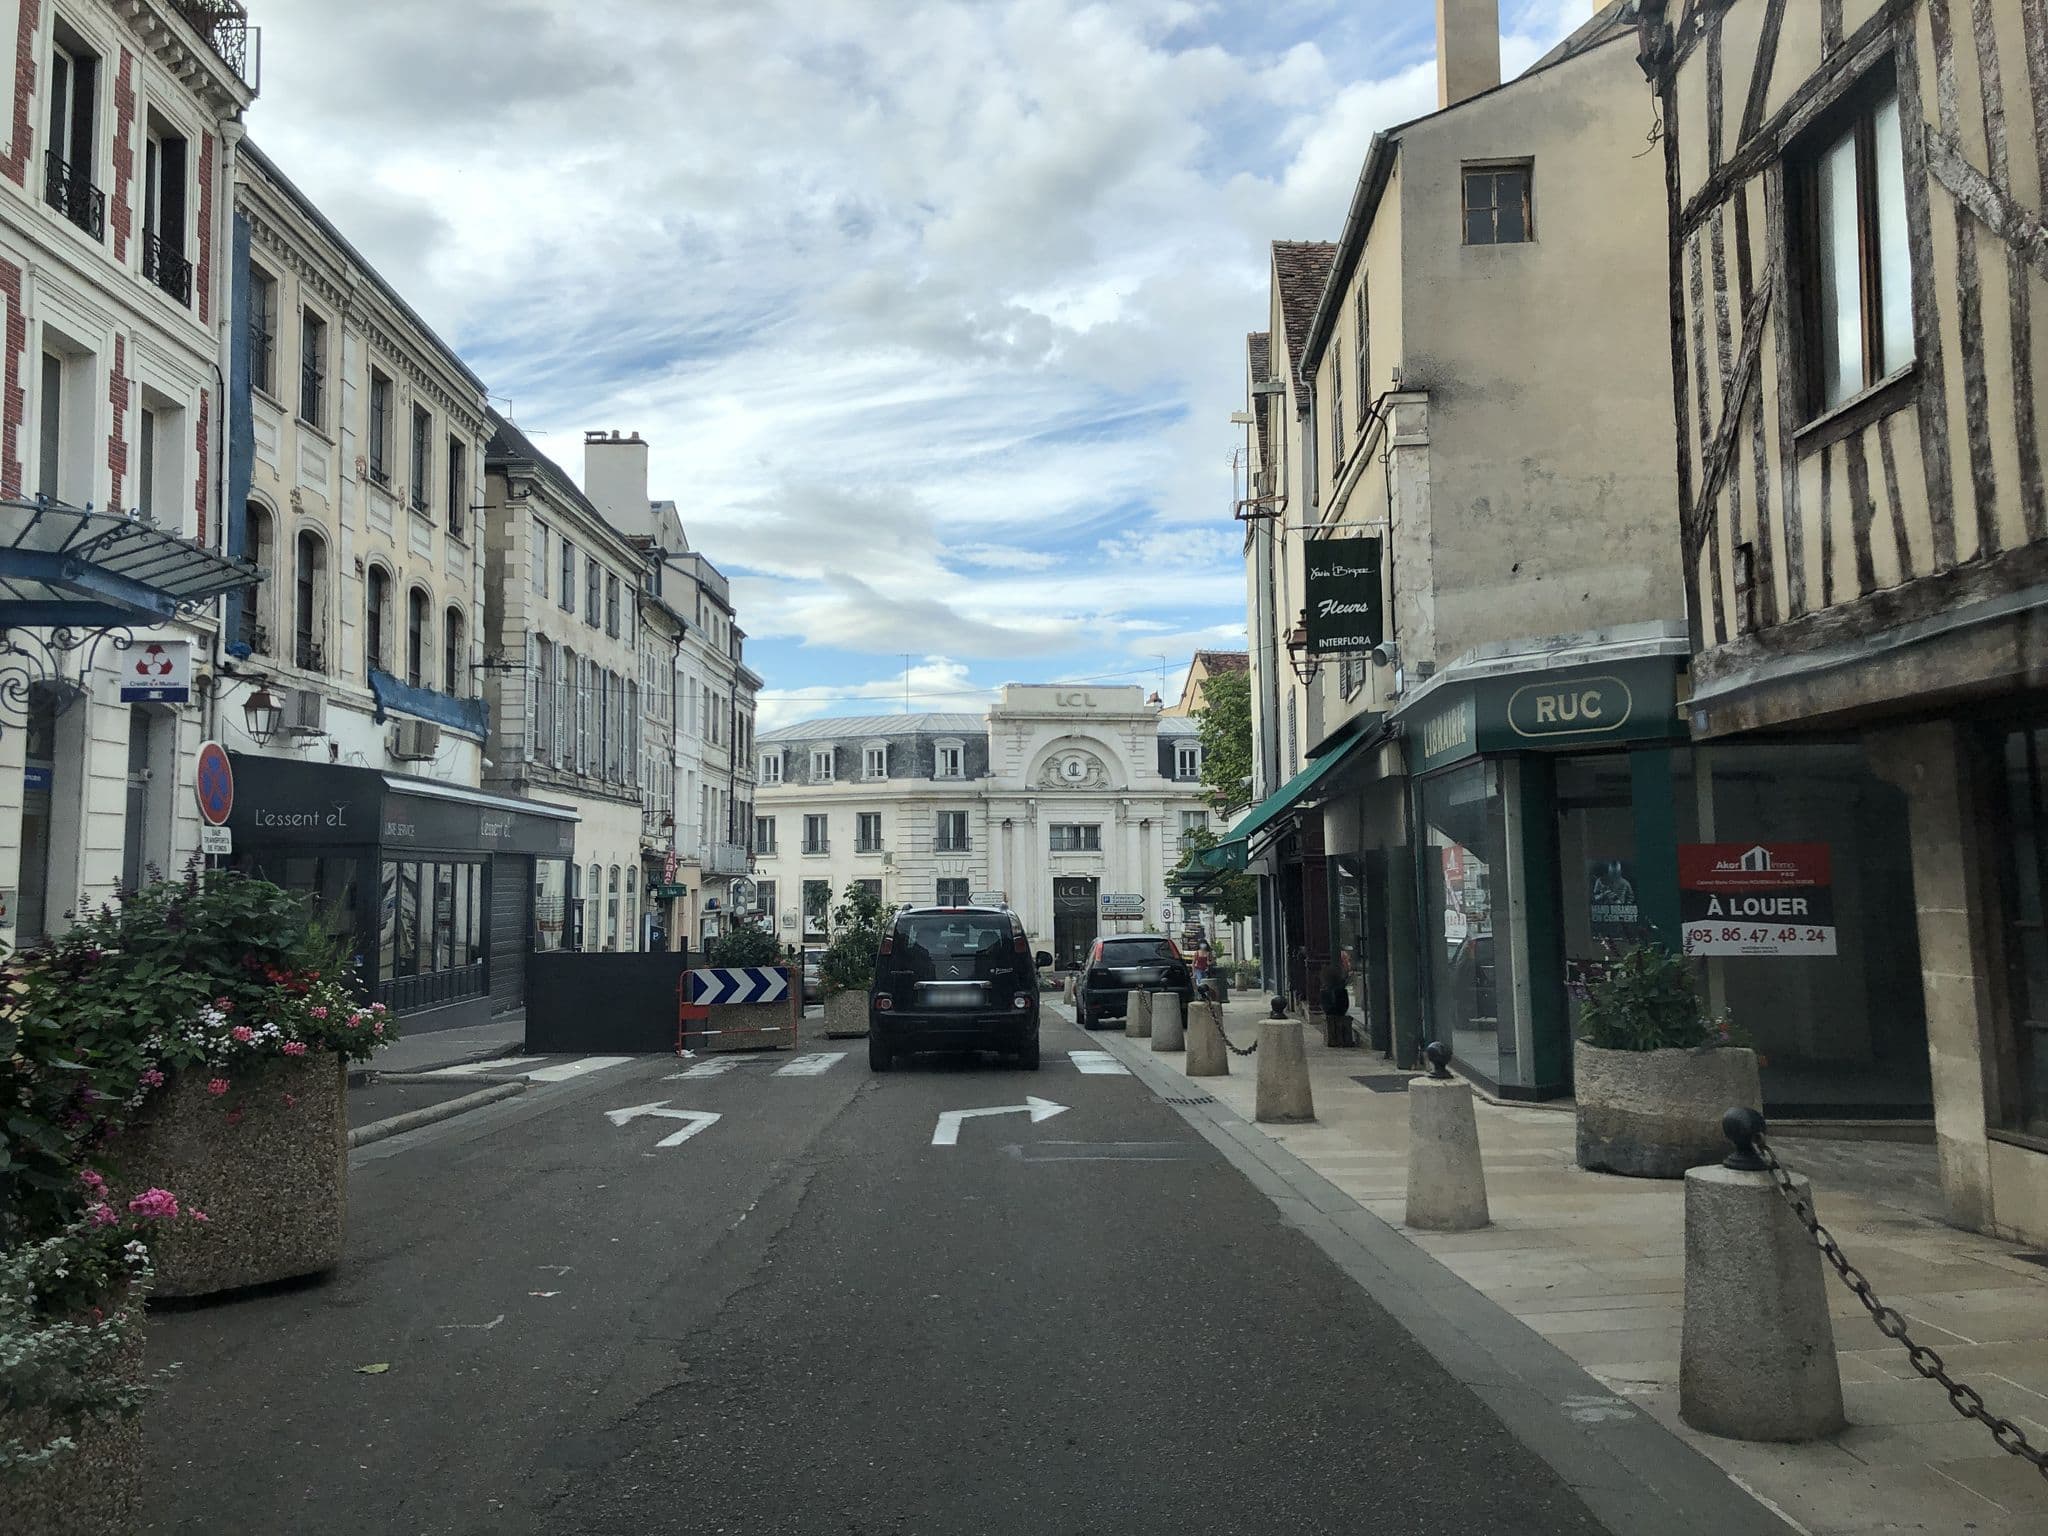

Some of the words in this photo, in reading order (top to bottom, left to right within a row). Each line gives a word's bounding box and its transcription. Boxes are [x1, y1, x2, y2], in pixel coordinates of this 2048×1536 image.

[1317, 598, 1369, 619] Fleurs
[1318, 635, 1371, 648] INTERFLORA
[1055, 692, 1097, 707] LCL
[1535, 690, 1603, 723] RUC
[1423, 701, 1468, 759] LIBRAIRIE
[664, 850, 675, 885] TABAC
[1715, 860, 1741, 870] Akor
[1060, 885, 1090, 897] LCL
[1706, 893, 1724, 916] À
[1729, 897, 1809, 916] LOUER
